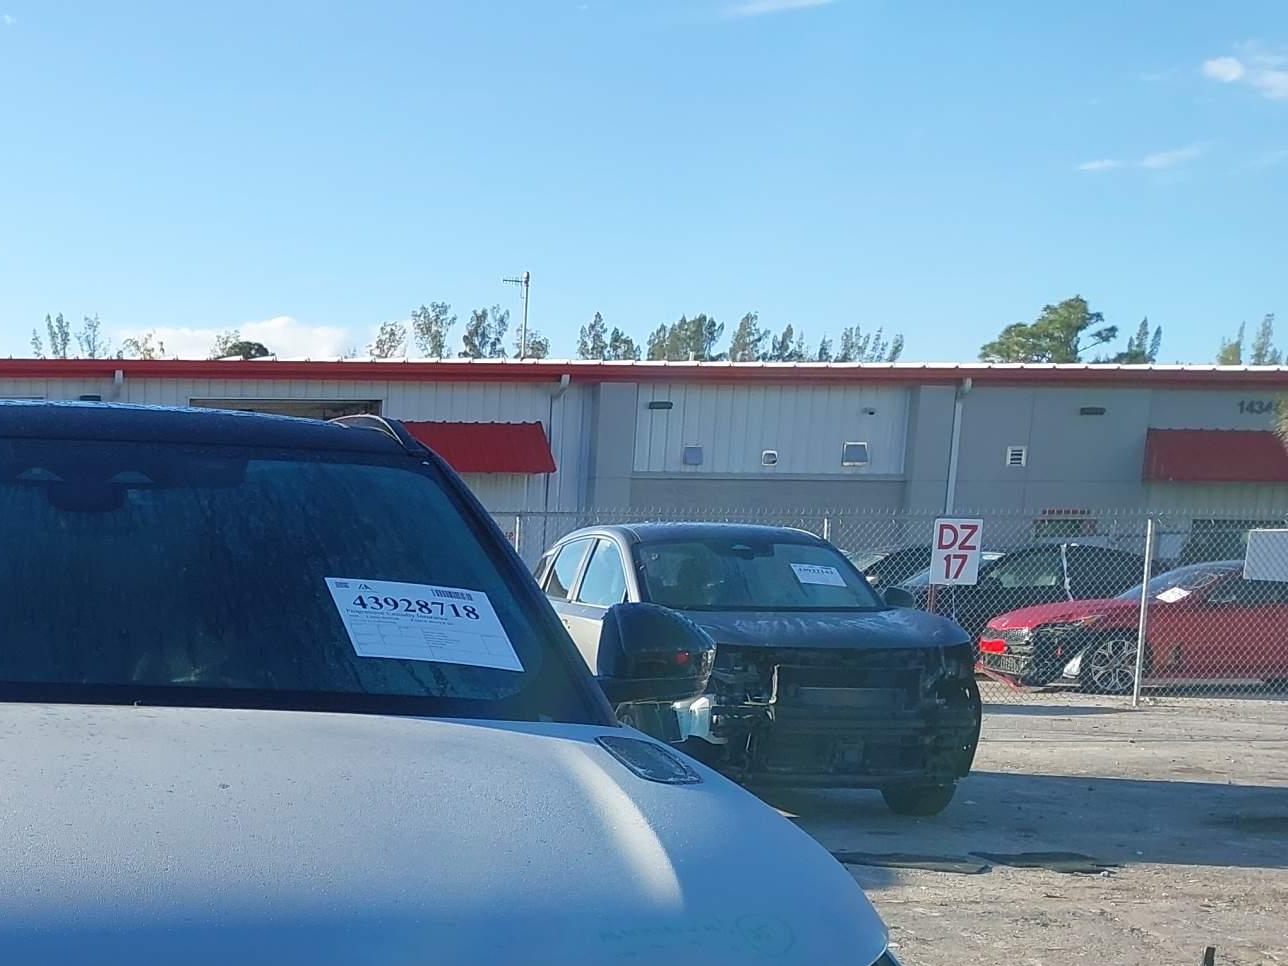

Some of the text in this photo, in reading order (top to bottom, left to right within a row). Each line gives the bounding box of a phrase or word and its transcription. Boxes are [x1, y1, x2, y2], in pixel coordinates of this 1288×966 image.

[937, 523, 979, 550] DZ
[943, 553, 968, 579] 17
[352, 595, 481, 620] 43928718
